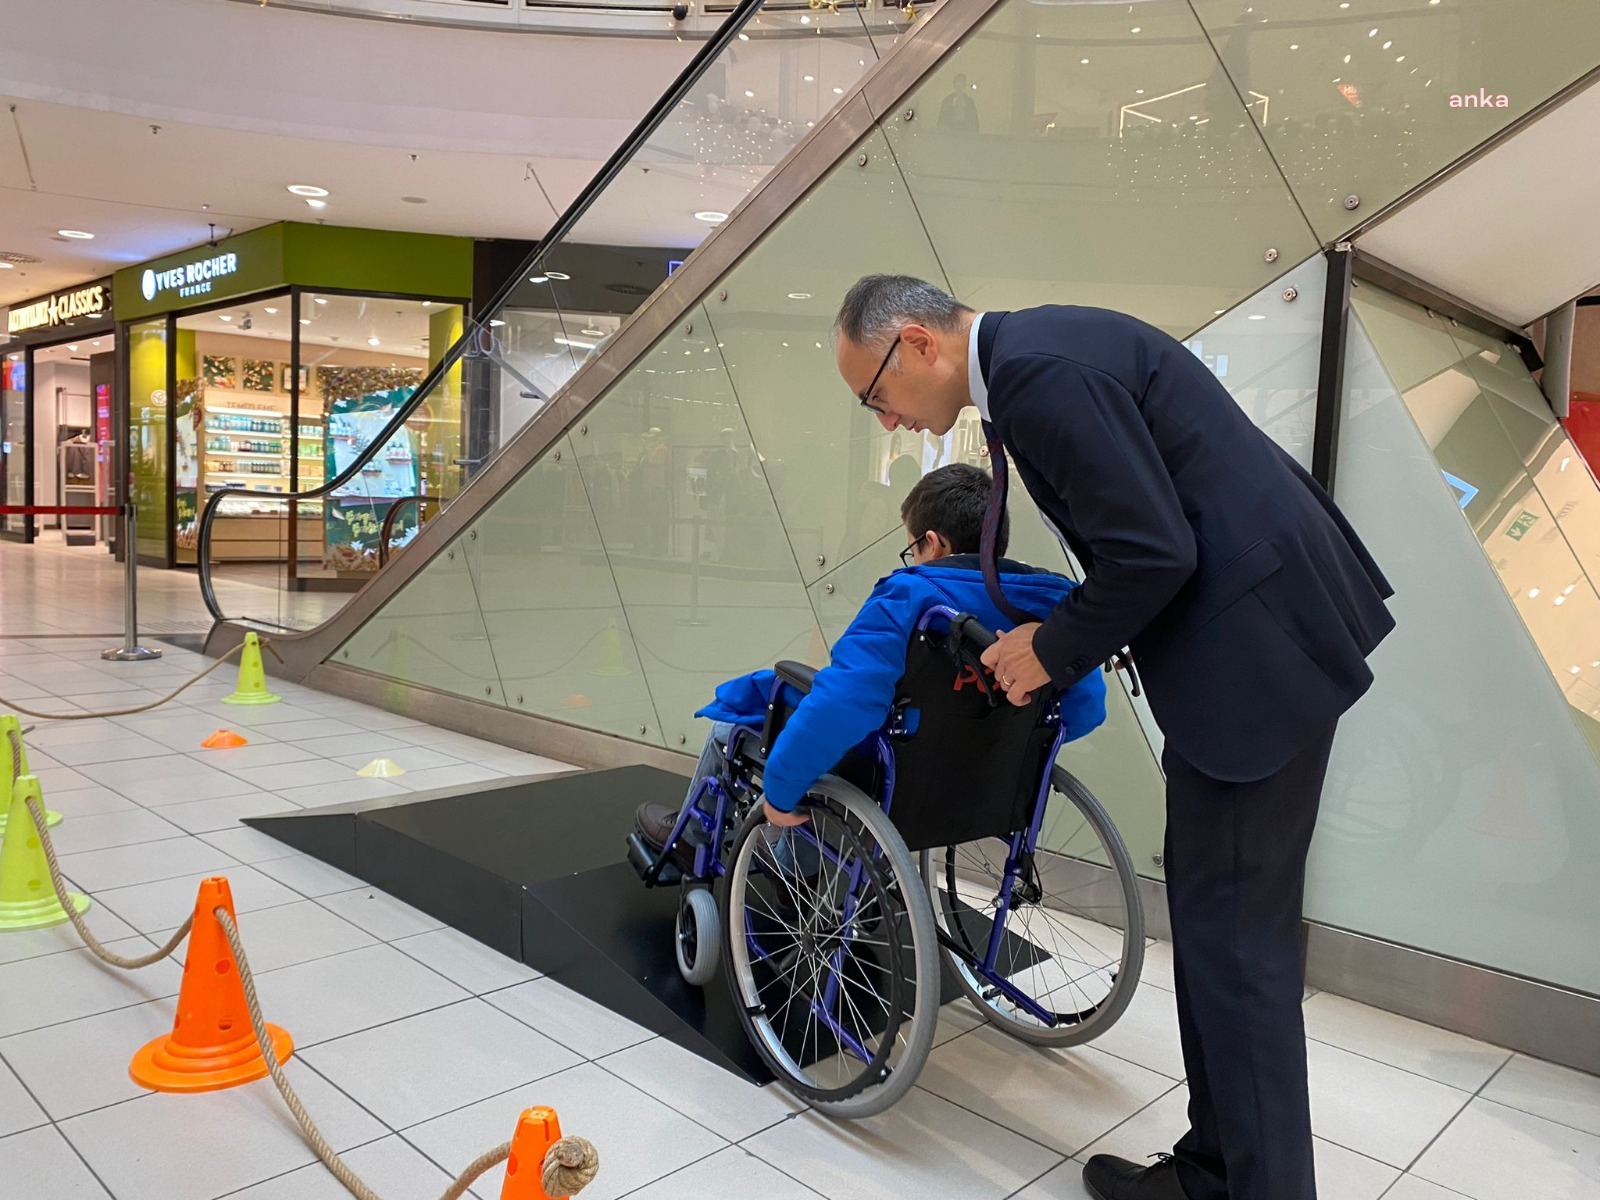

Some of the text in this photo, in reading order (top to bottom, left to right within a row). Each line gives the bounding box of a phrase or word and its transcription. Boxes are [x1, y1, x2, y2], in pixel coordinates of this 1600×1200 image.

[155, 253, 237, 291] YVES ROCHER
[58, 285, 103, 319] CLASSICS
[179, 281, 212, 298] FRANCE
